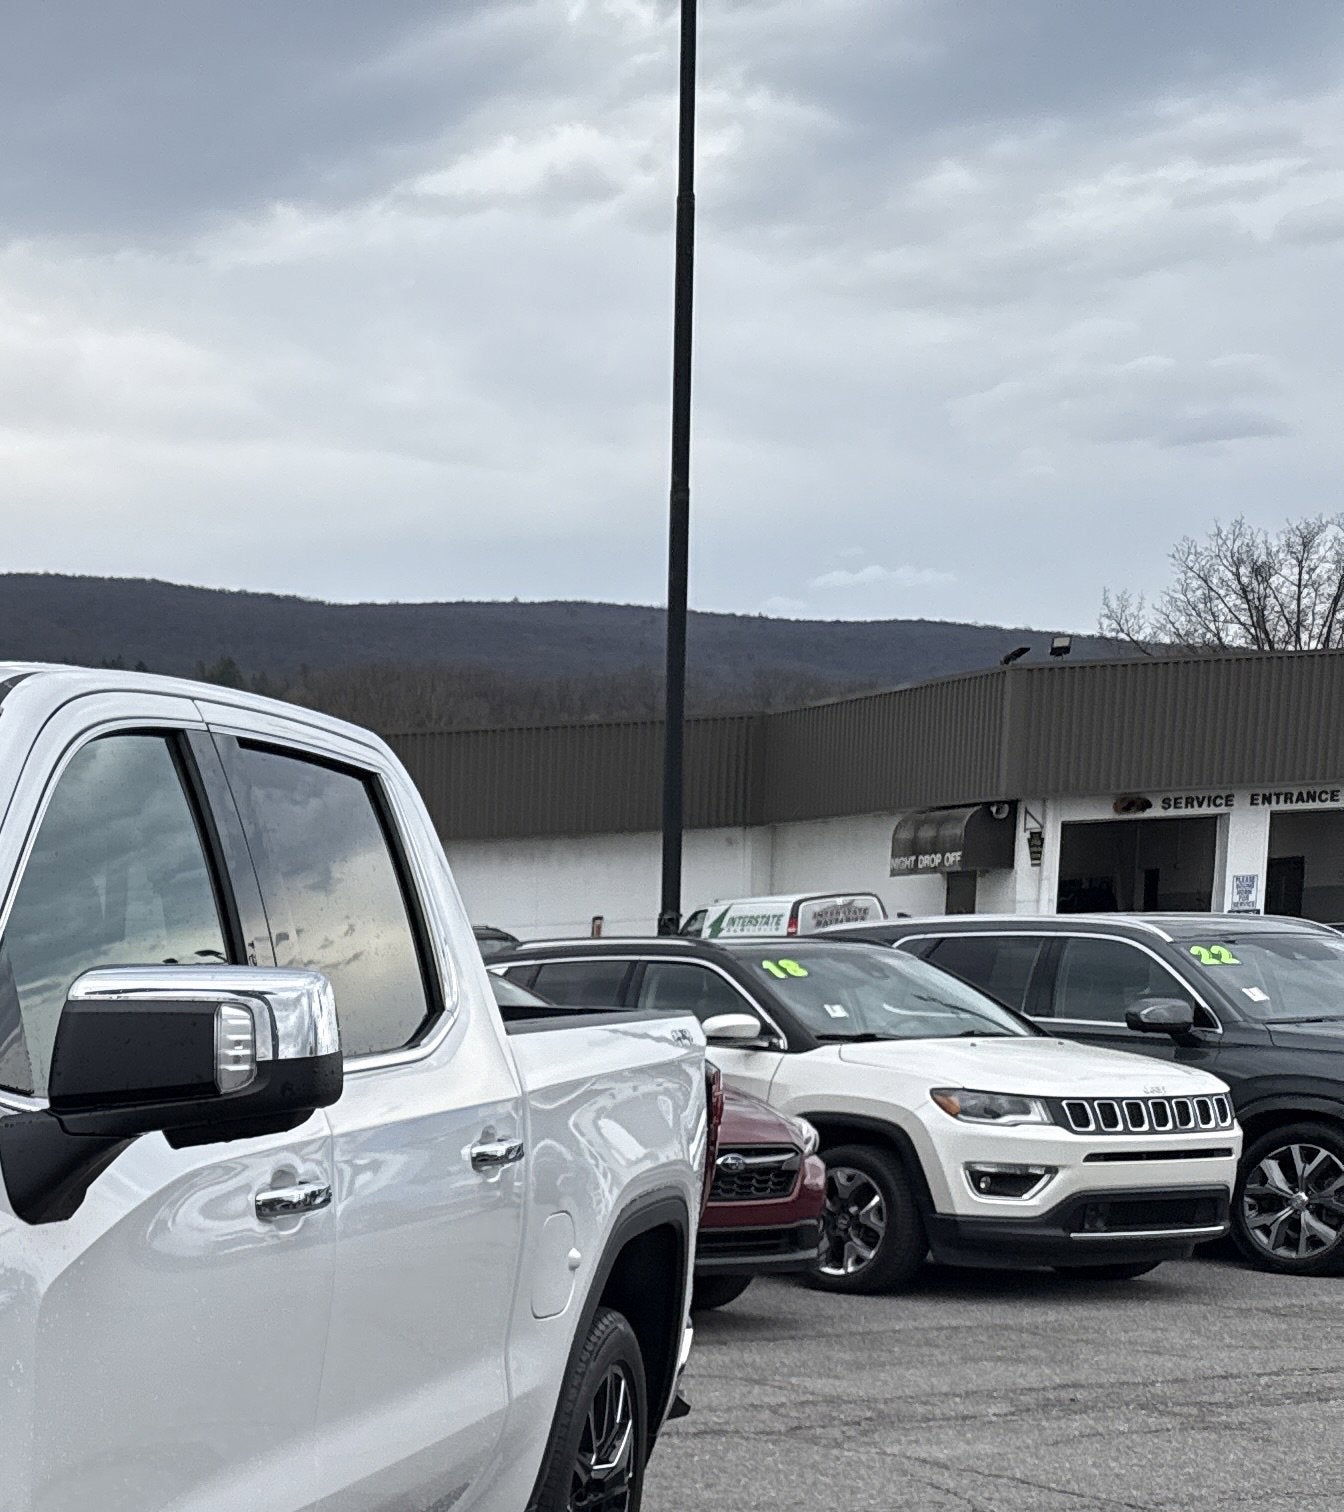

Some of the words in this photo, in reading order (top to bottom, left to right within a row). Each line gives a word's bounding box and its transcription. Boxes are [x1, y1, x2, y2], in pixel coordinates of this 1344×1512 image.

[1162, 794, 1235, 809] SERVICE
[1250, 790, 1340, 806] ENTRANCE
[891, 855, 916, 870] NIGHT
[917, 853, 942, 869] DROP
[944, 851, 962, 867] OFF
[725, 914, 784, 928] INTERSTATE
[1189, 945, 1242, 966] 22
[761, 959, 808, 979] 18
